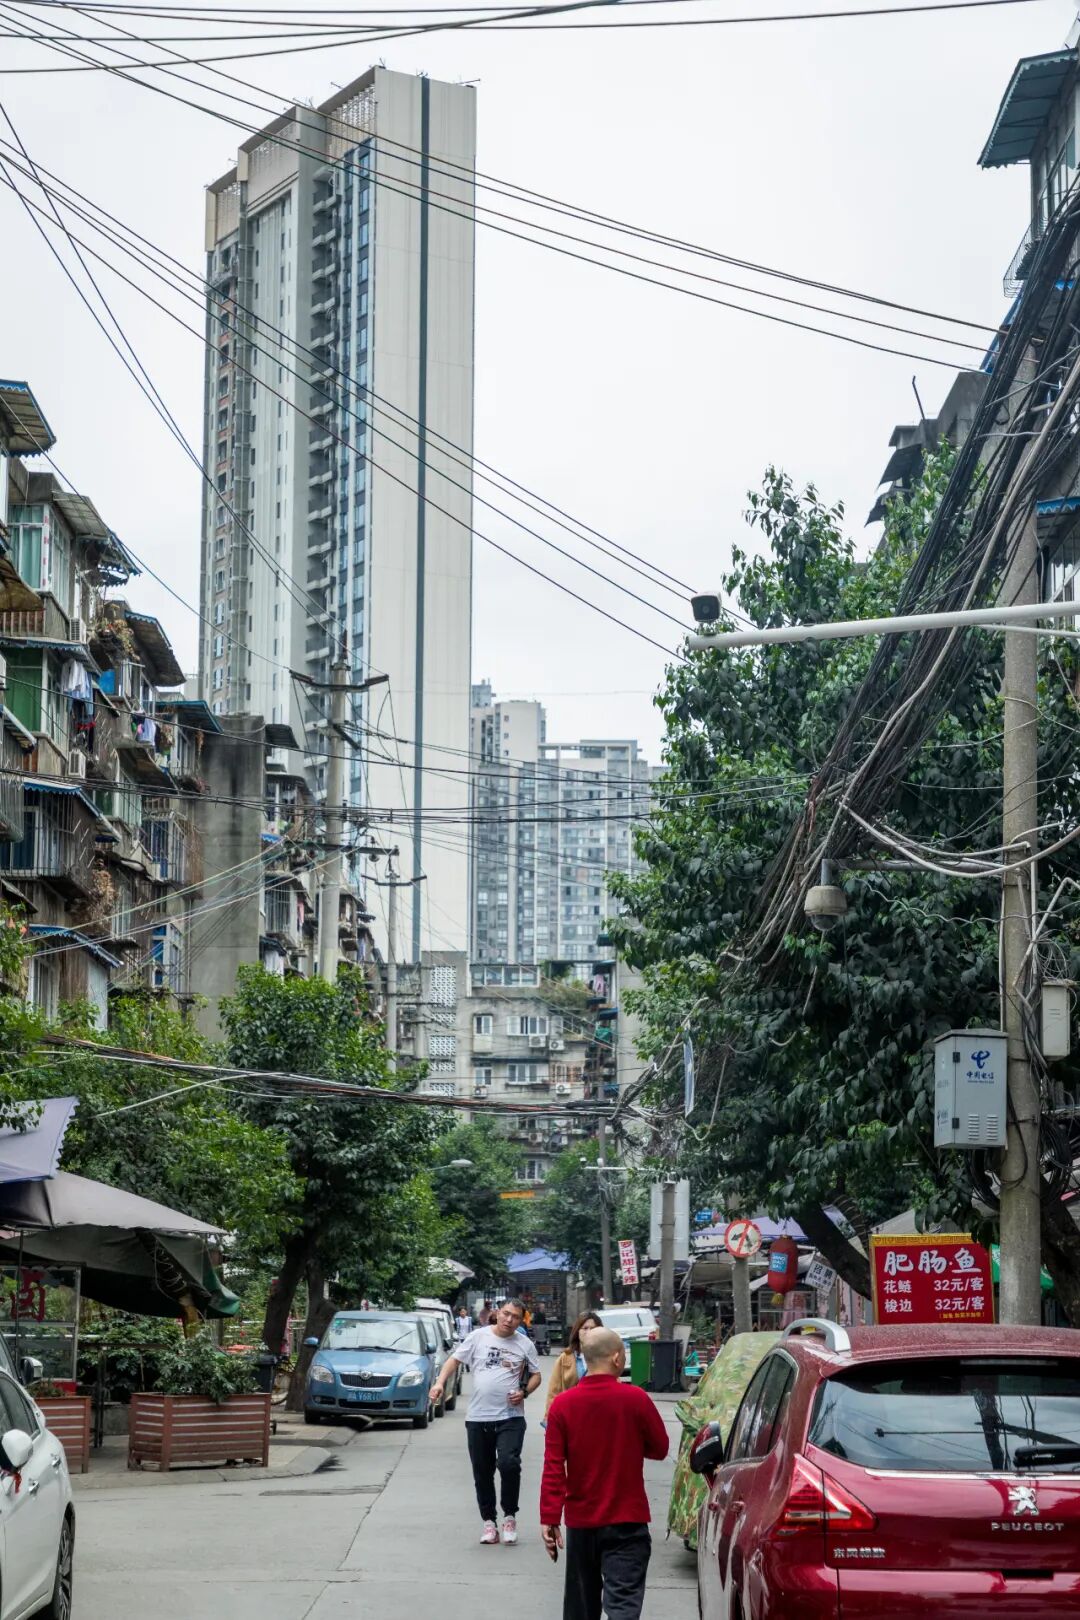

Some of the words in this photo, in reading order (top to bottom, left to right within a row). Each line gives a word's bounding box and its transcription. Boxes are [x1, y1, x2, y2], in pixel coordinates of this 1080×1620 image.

[884, 1280, 912, 1294] 花鲢
[934, 1277, 984, 1292] 32元/客
[884, 1299, 913, 1313] 梭边
[935, 1296, 985, 1311] 32元/客
[991, 1522, 1064, 1531] PEUGEOT
